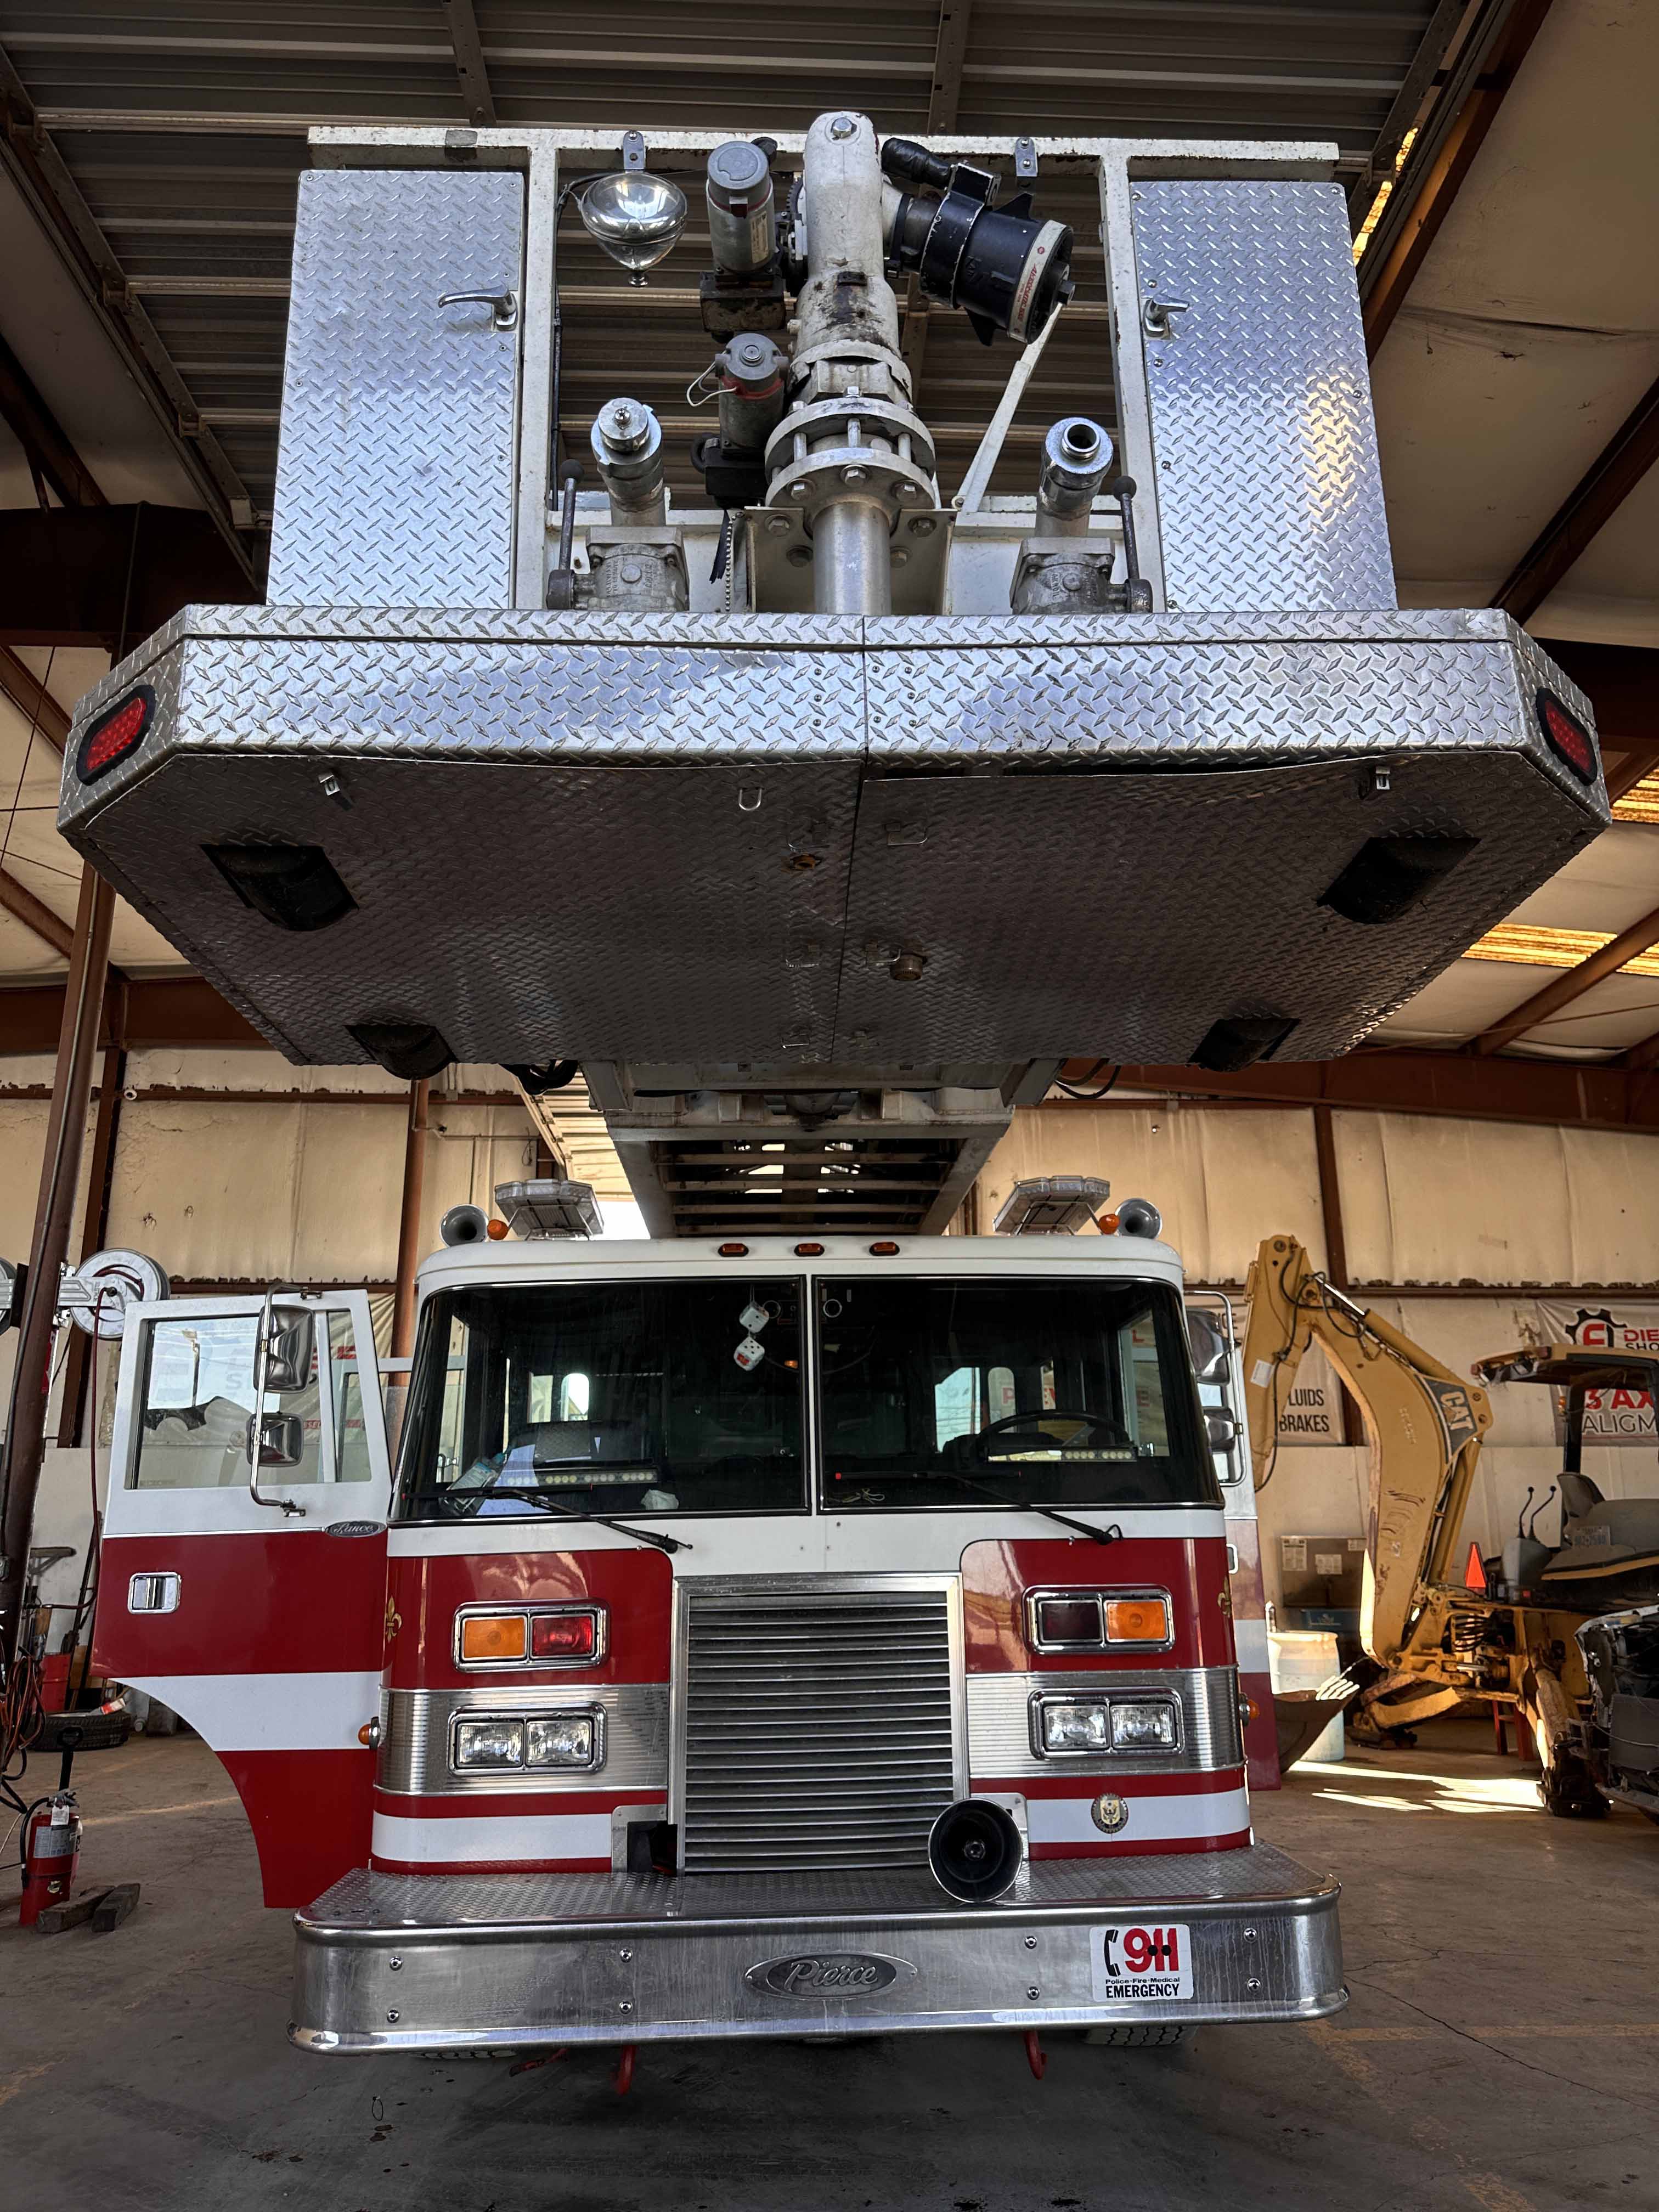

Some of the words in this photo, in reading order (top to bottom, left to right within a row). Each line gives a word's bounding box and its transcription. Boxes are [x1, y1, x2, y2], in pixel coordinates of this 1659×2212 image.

[1288, 1389, 1324, 1406] LUIDS
[1440, 1391, 1474, 1431] CAT
[1279, 1414, 1330, 1432] BRAKES
[334, 1523, 374, 1534] Lance
[1123, 1928, 1179, 1973] 911
[783, 1960, 878, 1991] Pierce
[1105, 1984, 1179, 1998] EMERGENCY
